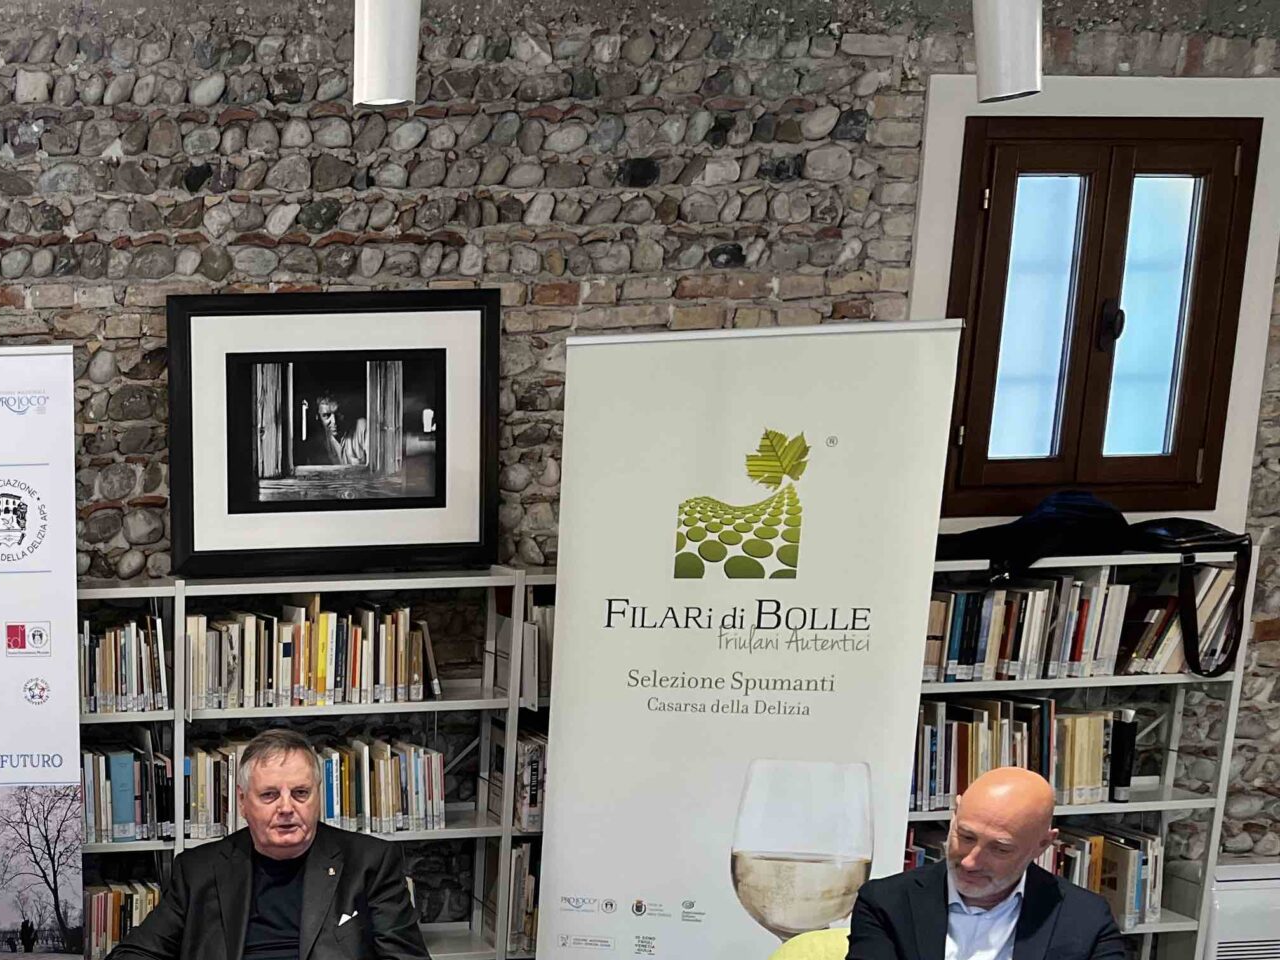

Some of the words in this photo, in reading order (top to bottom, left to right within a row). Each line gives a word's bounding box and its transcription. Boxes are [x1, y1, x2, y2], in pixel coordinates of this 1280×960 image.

[0, 550, 28, 561] DELLA
[27, 524, 48, 554] DELIZIA
[38, 504, 48, 521] APS
[720, 608, 746, 630] di
[754, 598, 872, 631] BOLLE
[785, 625, 871, 652] Autentici
[626, 669, 726, 690] Selezione
[730, 671, 836, 696] Spumanti
[646, 697, 707, 714] Casarsa
[710, 698, 750, 714] della
[754, 700, 811, 716] Delizia
[0, 754, 64, 770] FUTURO
